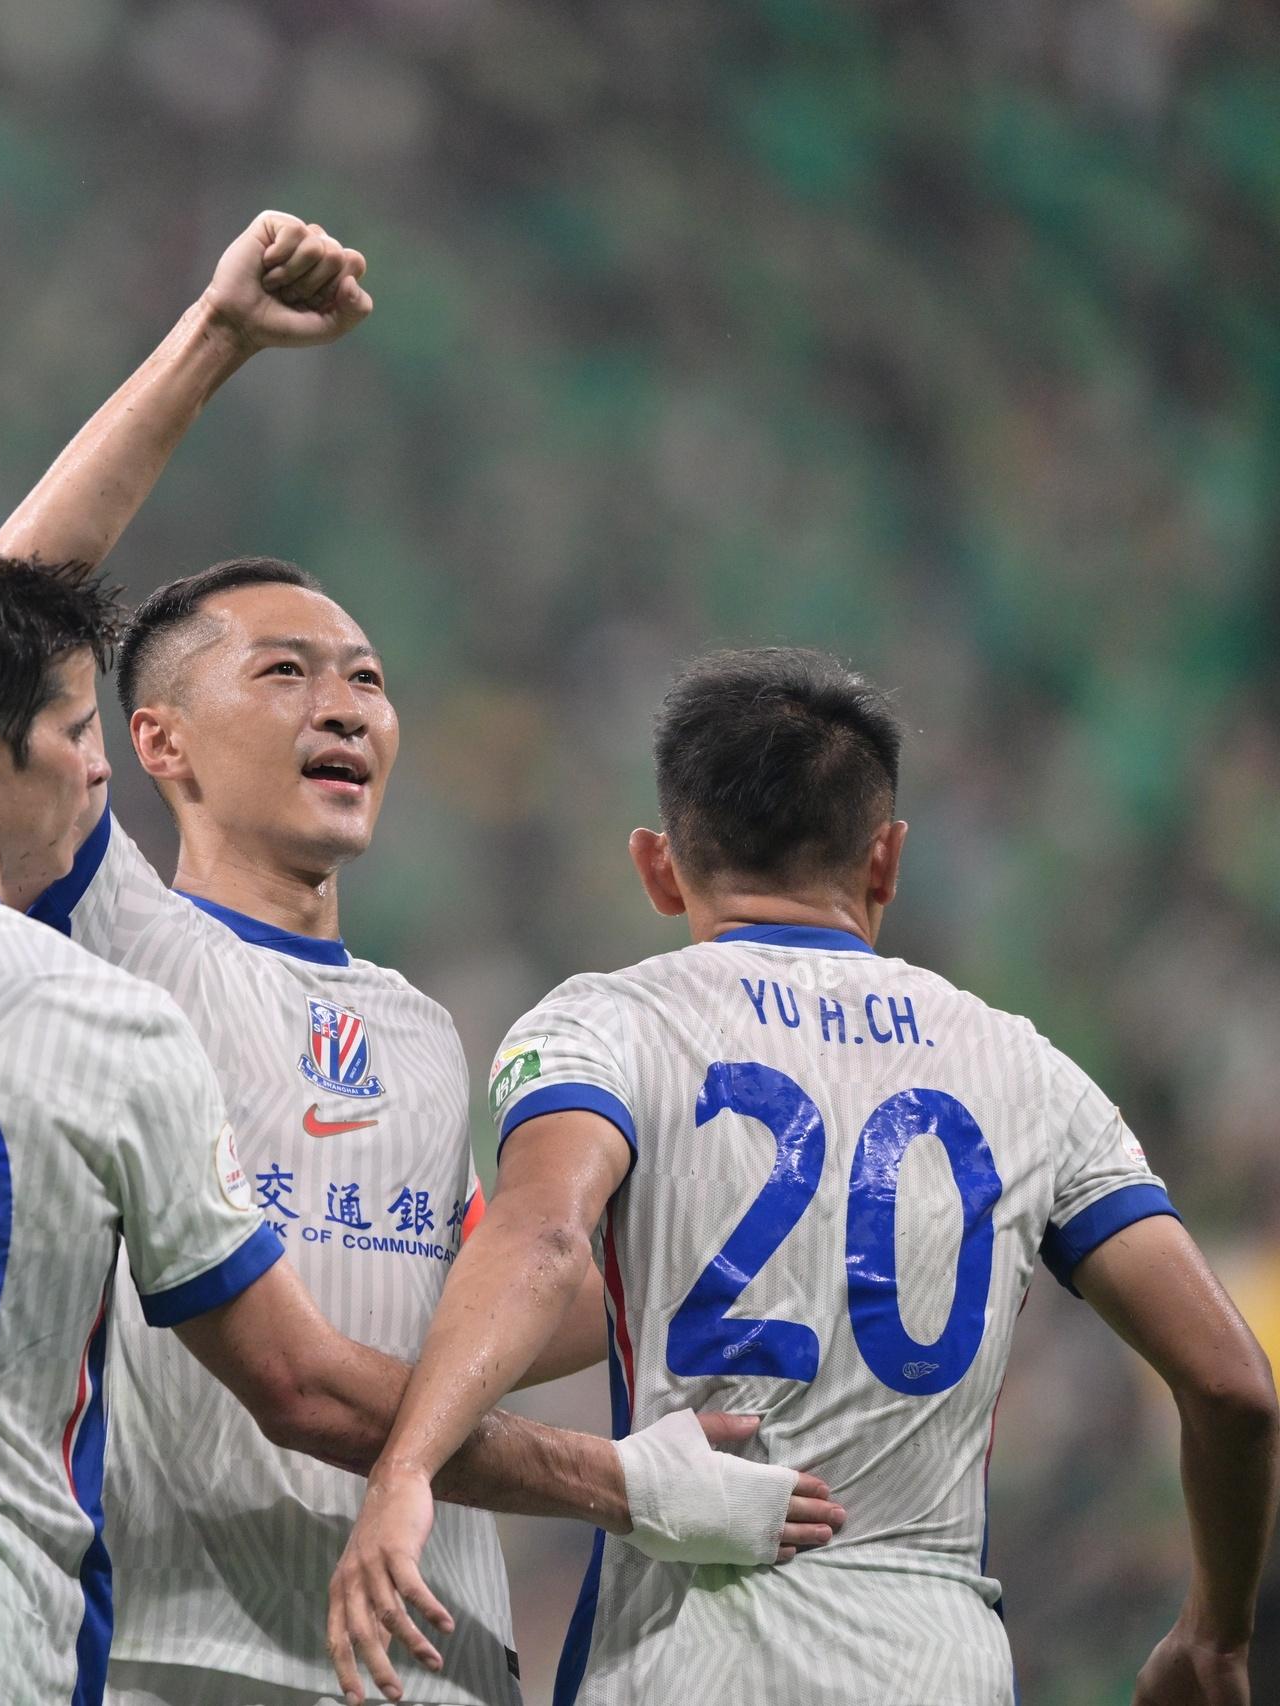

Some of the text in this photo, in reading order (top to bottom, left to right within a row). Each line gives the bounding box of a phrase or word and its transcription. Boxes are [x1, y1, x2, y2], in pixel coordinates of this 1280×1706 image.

[740, 978, 935, 1047] YU H.CH.
[313, 1023, 339, 1039] SFC
[323, 1079, 359, 1094] SHANGHAI
[302, 1226, 332, 1244] OF
[666, 1060, 1003, 1397] 20
